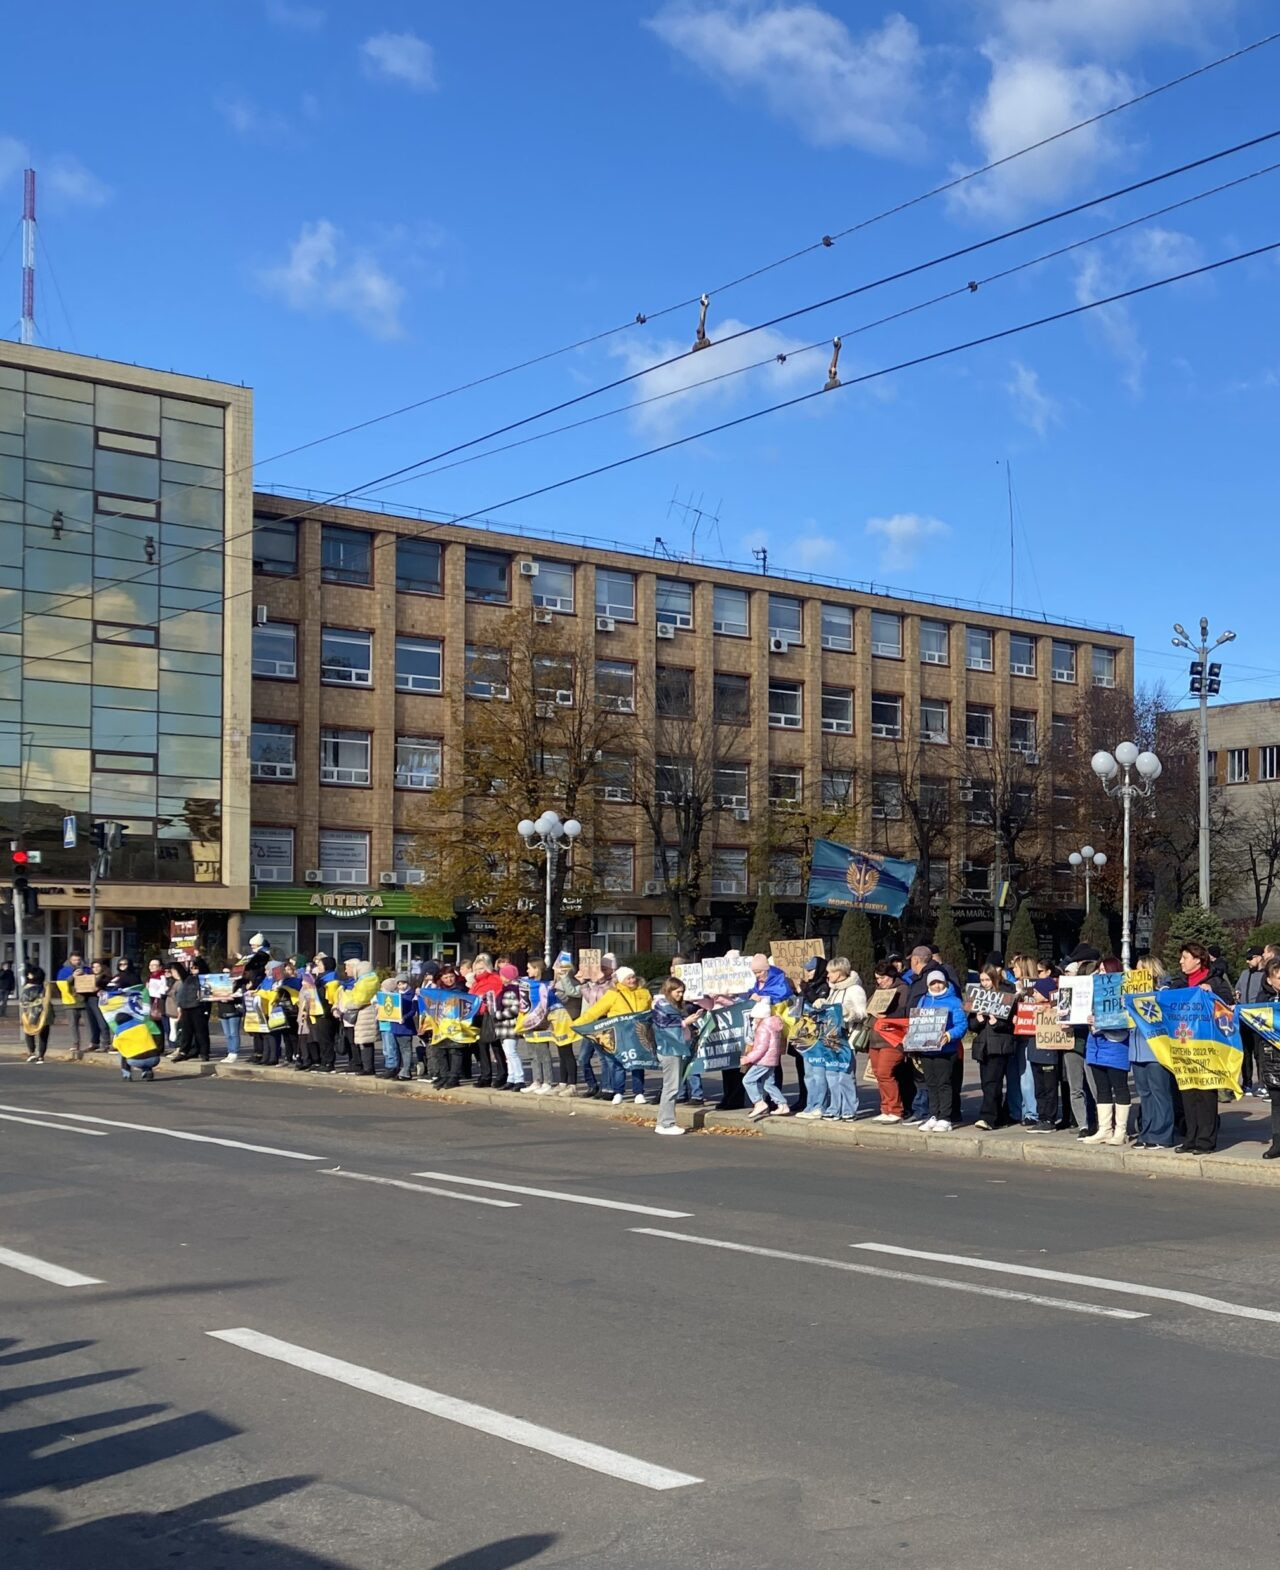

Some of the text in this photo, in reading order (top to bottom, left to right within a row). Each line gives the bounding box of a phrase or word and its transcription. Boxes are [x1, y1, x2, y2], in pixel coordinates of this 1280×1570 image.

[309, 894, 384, 906] АПТЕКА
[828, 898, 887, 911] МОРСЬКА ПІХОТА
[970, 987, 1004, 1004] ПОЛОН
[972, 1000, 1010, 1017] ВБИВАЄ
[621, 1048, 637, 1063] 36
